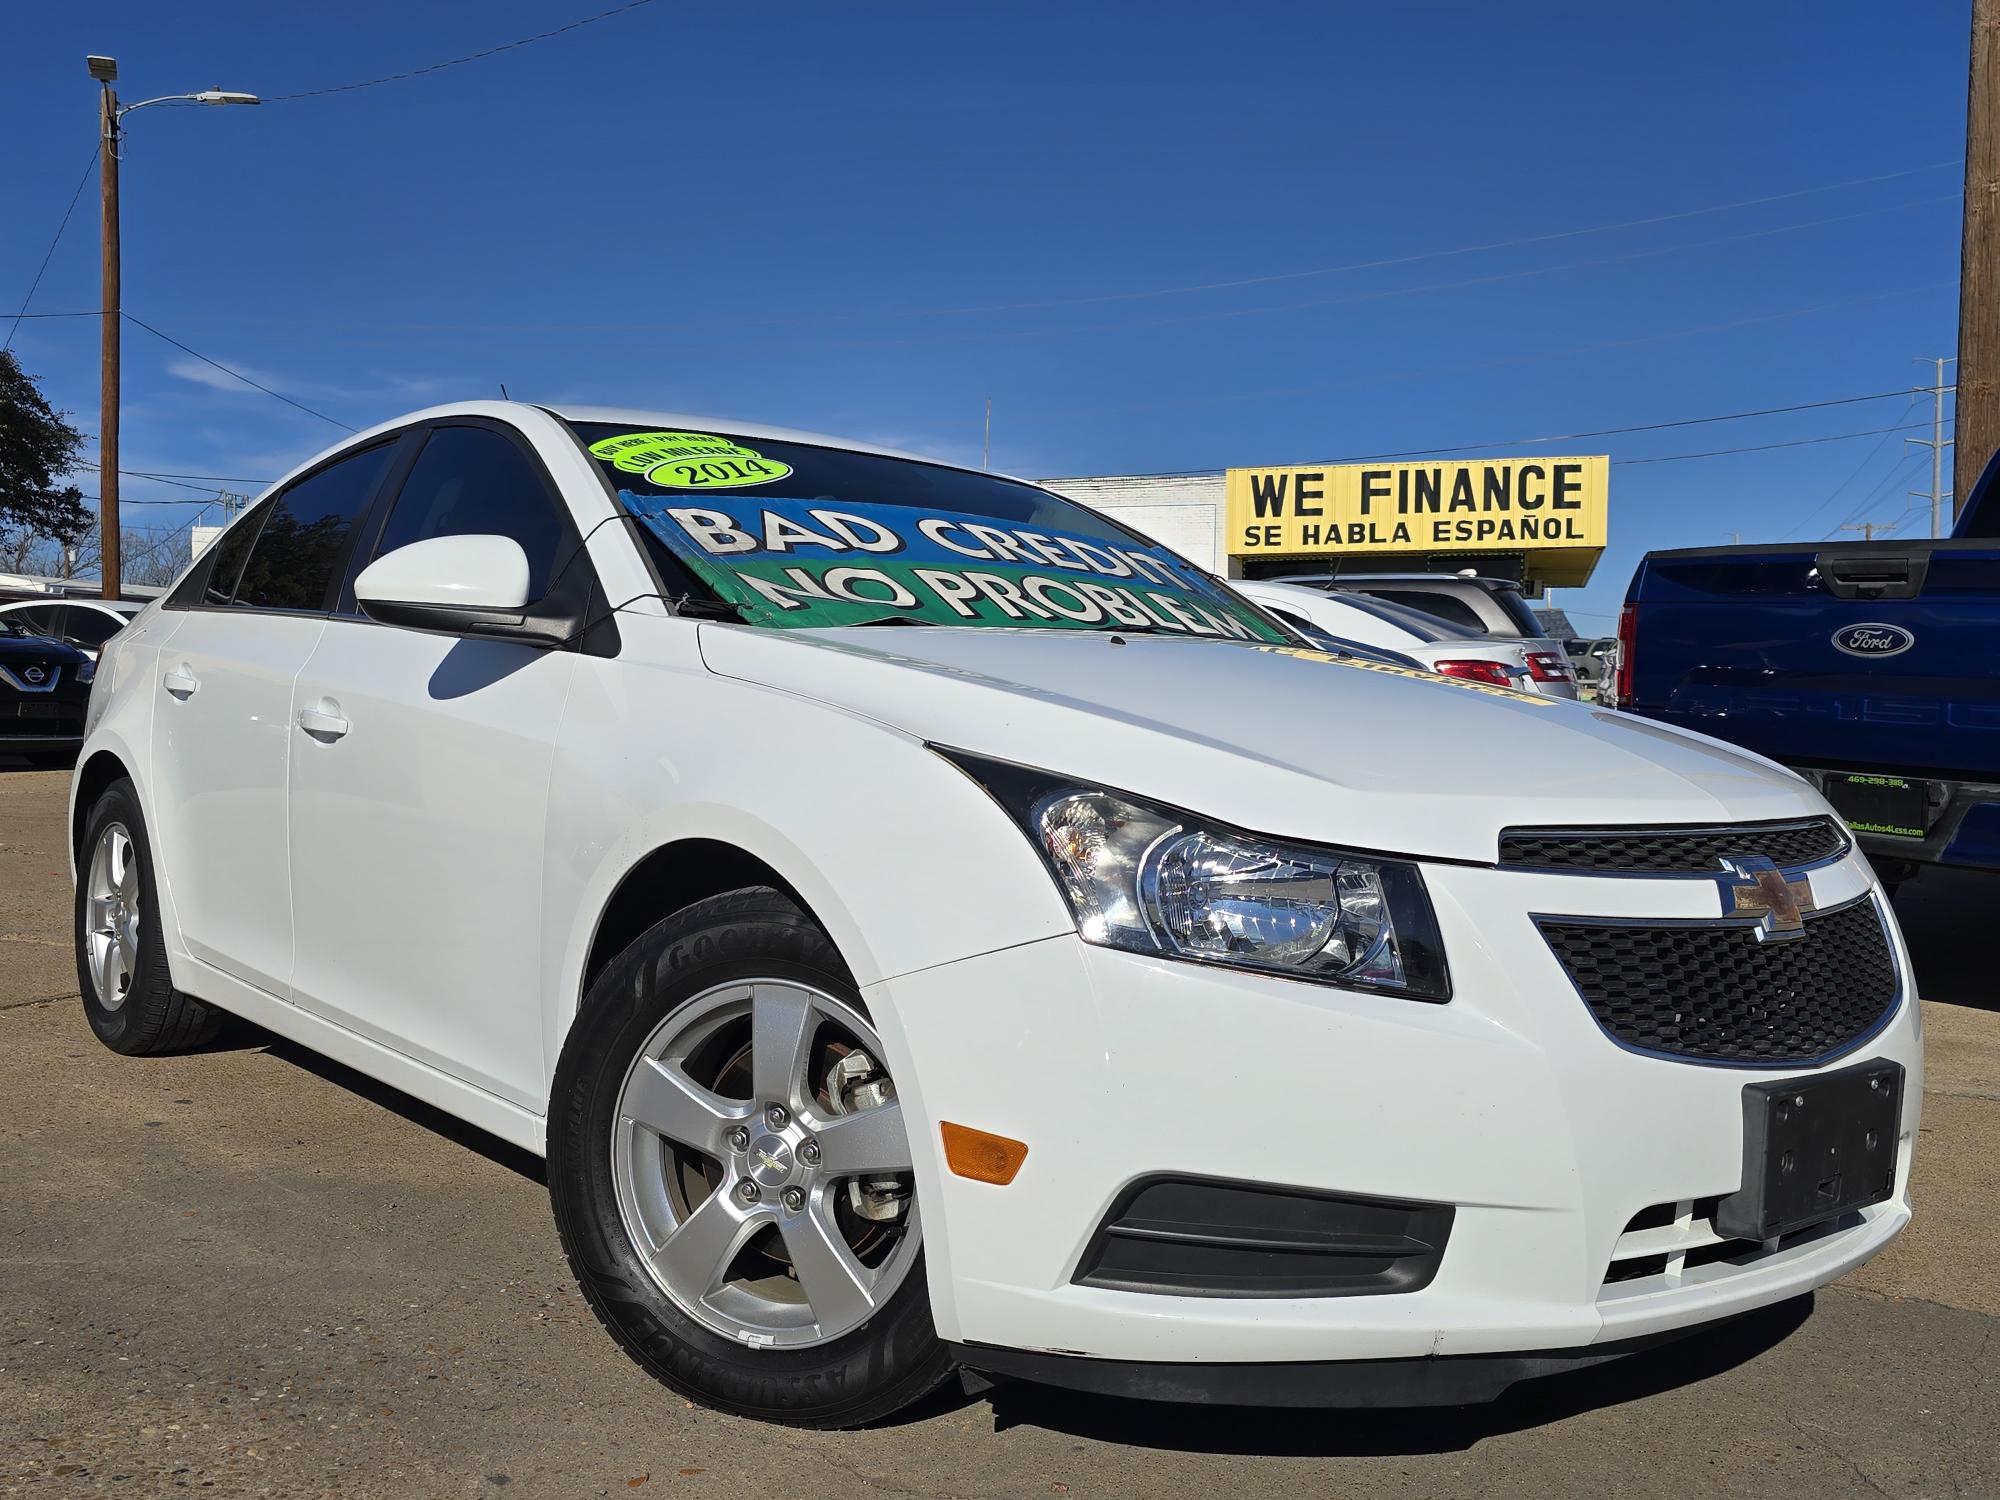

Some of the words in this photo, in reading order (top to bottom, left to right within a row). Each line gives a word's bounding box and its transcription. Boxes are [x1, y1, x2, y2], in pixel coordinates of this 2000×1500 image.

[596, 444, 620, 455] BUY
[616, 438, 648, 448] HERE
[622, 450, 667, 467] LOW
[661, 446, 745, 457] MILEAGE
[674, 458, 774, 484] 2014
[1250, 473, 1324, 518] WE
[1361, 464, 1582, 515] FINANCE
[1244, 525, 1282, 546] SE
[1302, 522, 1411, 546] HABLA
[1433, 514, 1584, 543] ESPAÑOL
[665, 507, 903, 554] BAD
[916, 518, 1194, 591] CREDIT
[734, 566, 922, 611] NO
[911, 567, 1265, 642] PROBLEM
[1850, 629, 1893, 649] Ford
